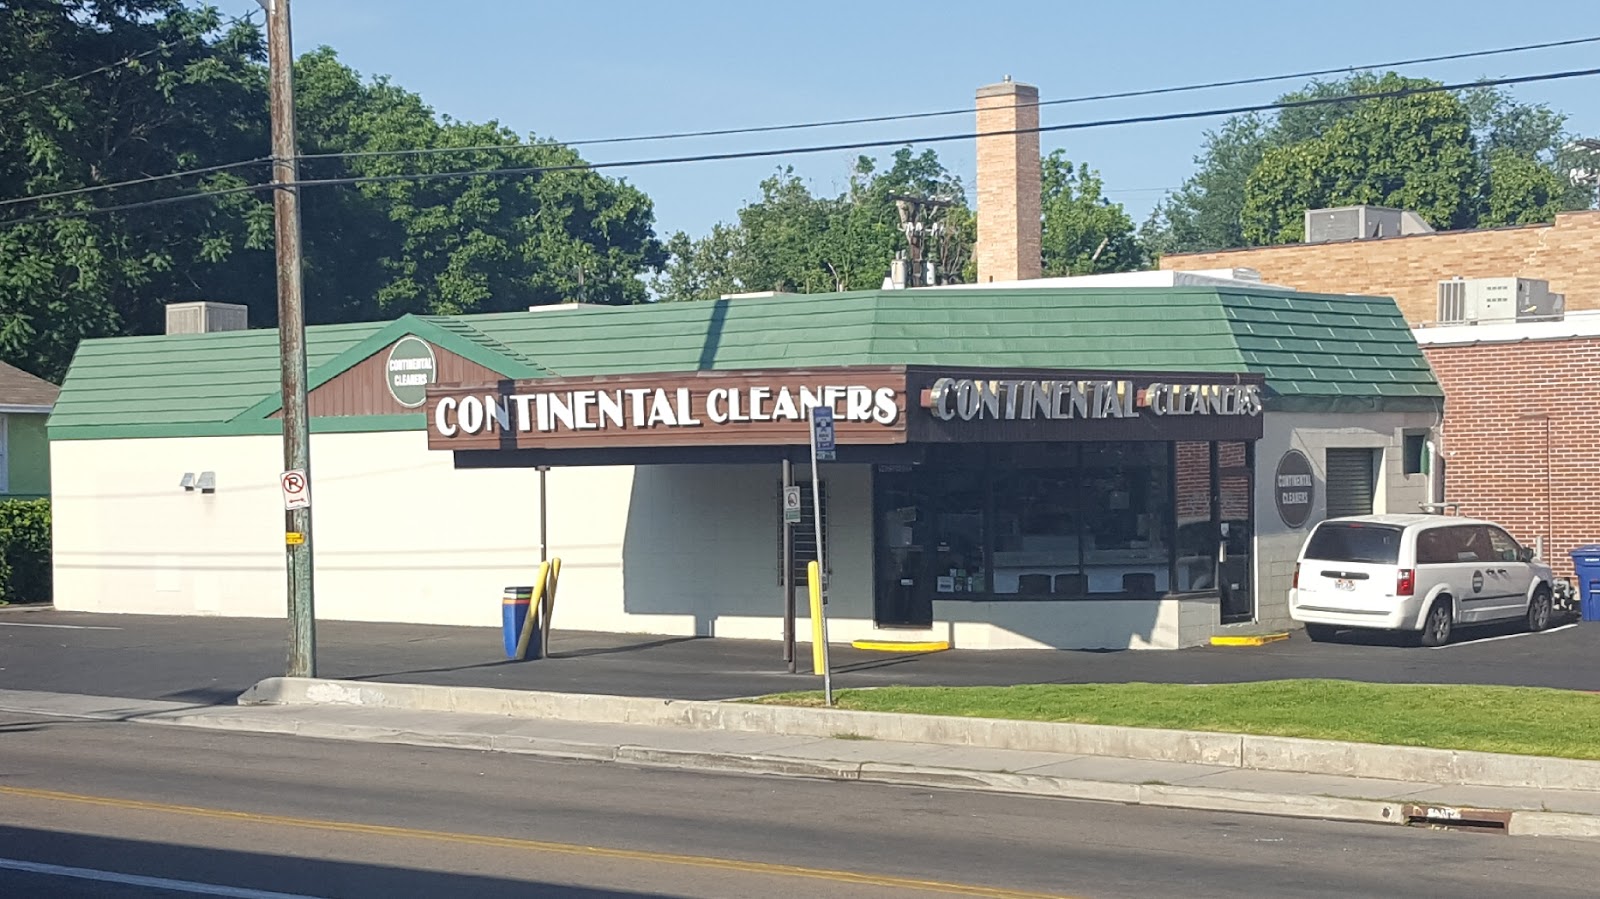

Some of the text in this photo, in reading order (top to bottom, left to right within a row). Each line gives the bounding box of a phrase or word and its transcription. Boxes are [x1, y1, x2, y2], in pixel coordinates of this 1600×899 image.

[434, 385, 898, 437] CONTINENTAL CLEANERS
[930, 377, 1262, 422] CONTINENTAL CLEANERS
